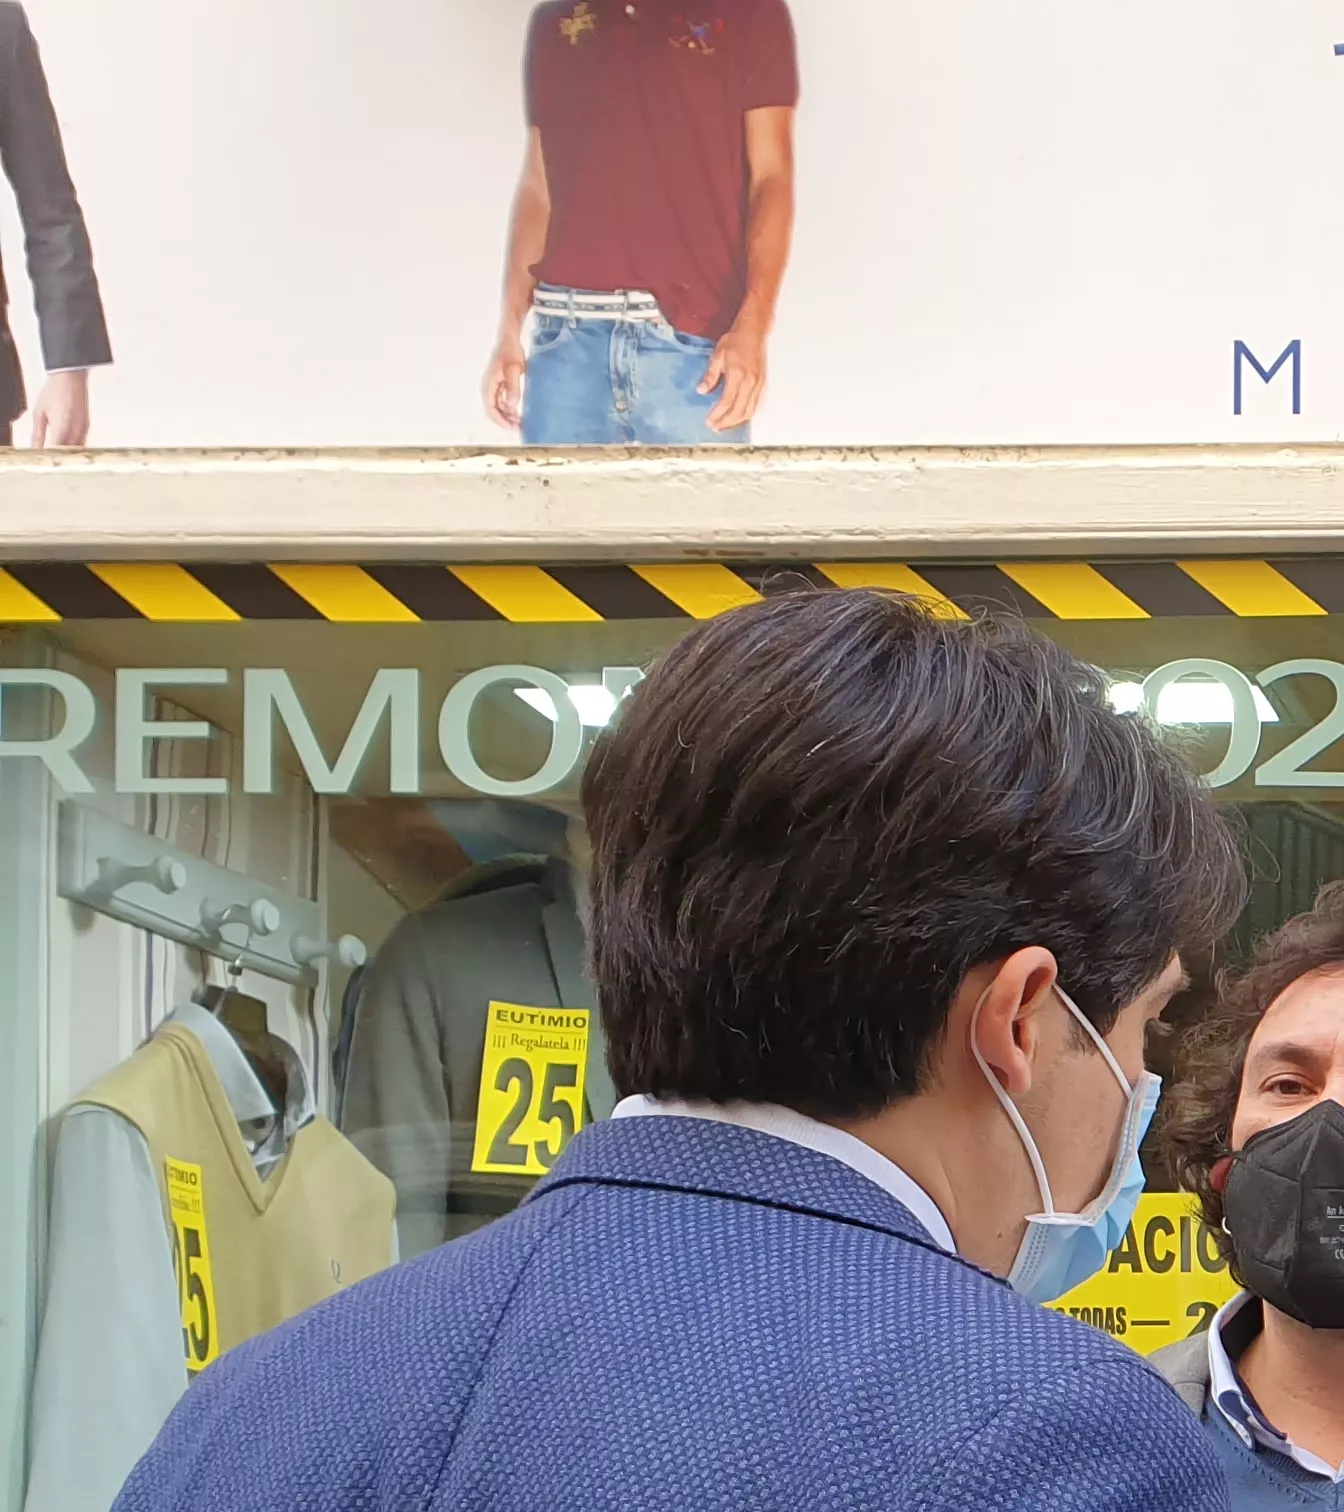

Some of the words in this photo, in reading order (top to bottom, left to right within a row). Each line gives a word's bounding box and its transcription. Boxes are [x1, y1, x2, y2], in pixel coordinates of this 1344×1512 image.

[0, 663, 655, 796] REMO
[495, 1009, 587, 1029] EUTIMIO
[510, 1032, 570, 1052] Regalatela
[484, 1056, 578, 1169] 25
